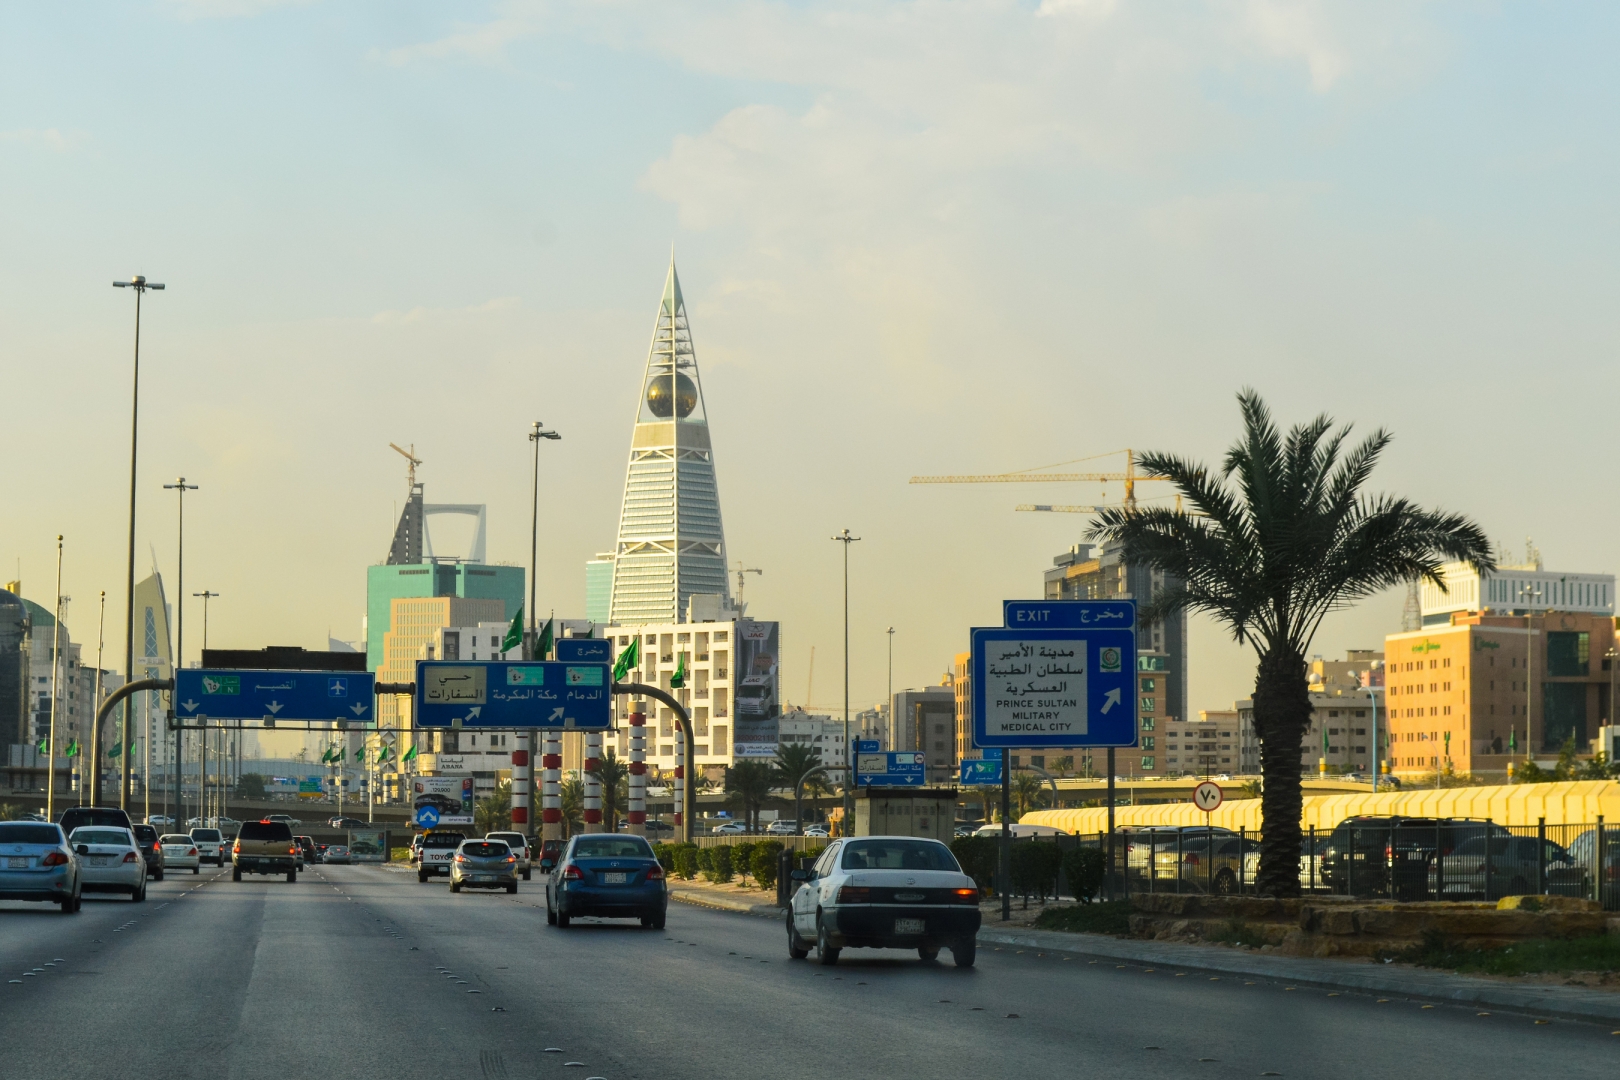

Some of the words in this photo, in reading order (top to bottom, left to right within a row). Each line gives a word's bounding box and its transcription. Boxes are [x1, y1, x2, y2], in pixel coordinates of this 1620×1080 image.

[1016, 610, 1050, 622] EXIT
[1080, 607, 1124, 623] مخرج
[576, 645, 604, 657] مخرج
[999, 642, 1034, 660] الأمير
[1039, 646, 1075, 660] مدينة
[989, 663, 1031, 678] الطبية
[1036, 662, 1084, 678] سلطان
[254, 679, 296, 693] القصيم
[438, 674, 472, 686] حي
[227, 686, 234, 694] N
[537, 689, 558, 700] مكة
[1005, 681, 1067, 696] العسكرية
[428, 689, 483, 702] السفارات
[492, 689, 534, 702] المكرمة
[566, 689, 602, 702] الدمام
[996, 700, 1033, 708] PRINCE
[1037, 699, 1077, 707] SULTAN
[1012, 711, 1060, 720] MILITARY
[1001, 723, 1046, 732] MEDICAL
[1050, 722, 1072, 731] CITY
[1200, 789, 1216, 804] ٧٠
